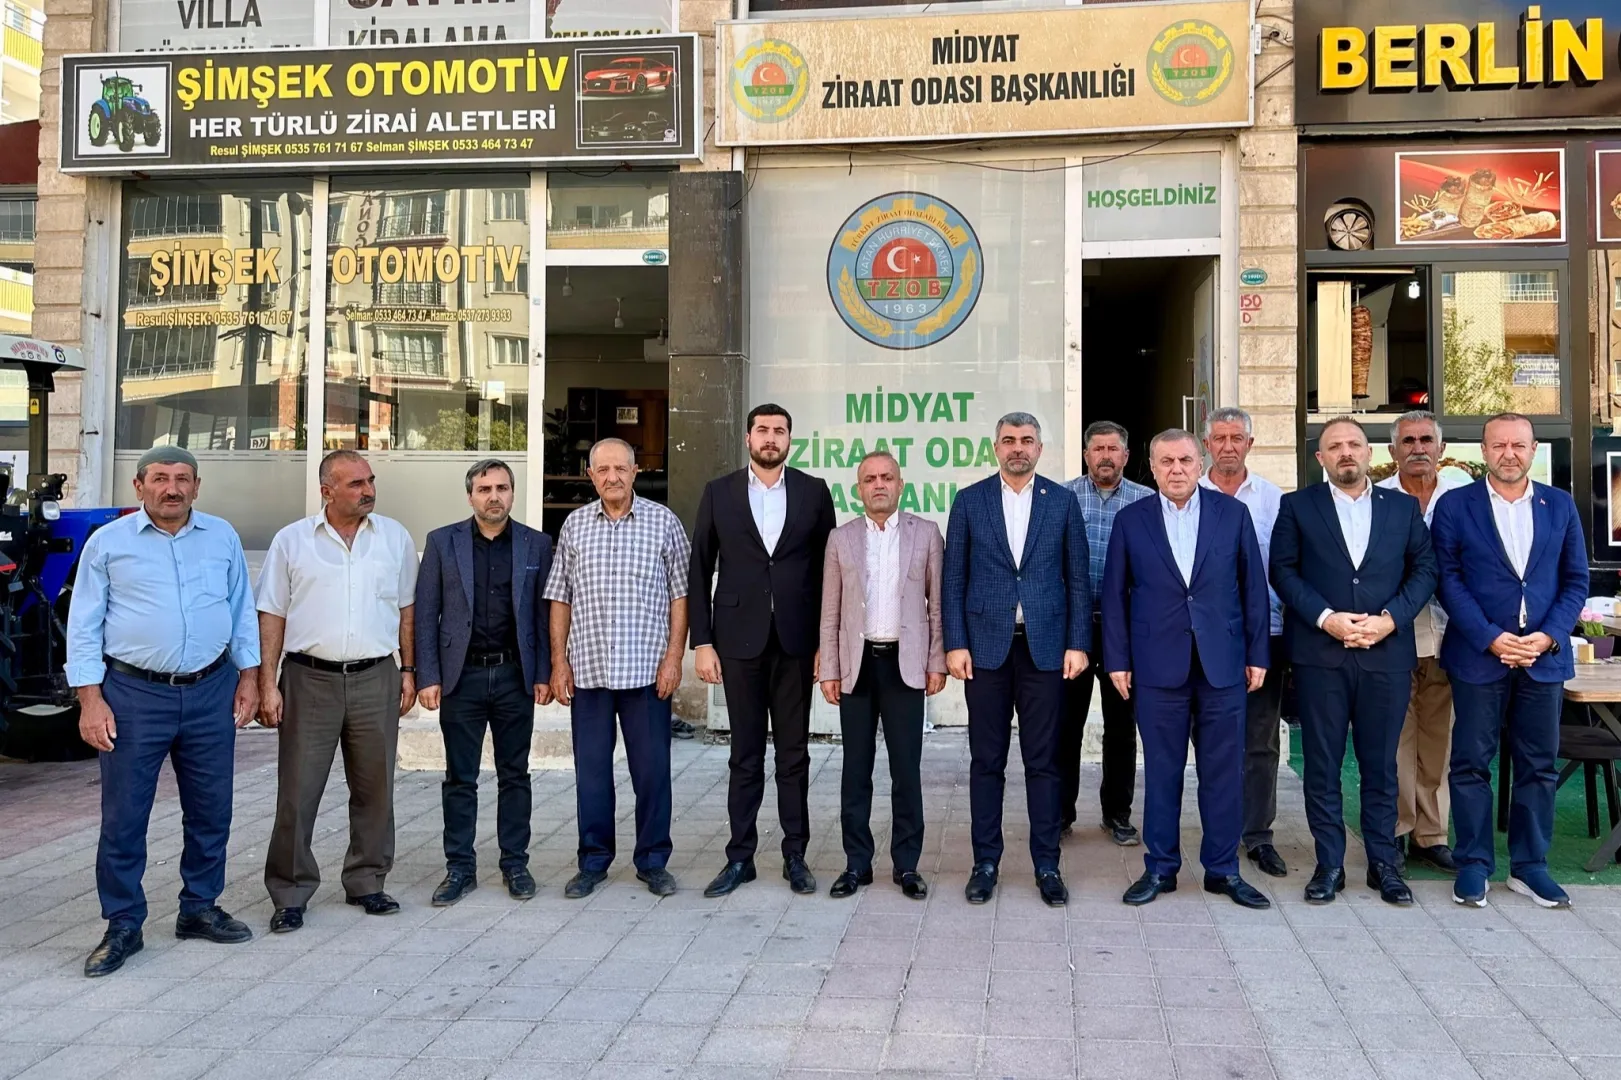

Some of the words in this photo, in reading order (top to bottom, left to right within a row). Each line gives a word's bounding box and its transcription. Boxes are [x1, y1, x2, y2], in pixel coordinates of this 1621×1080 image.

[932, 29, 1020, 65] MİDYAT
[1318, 4, 1604, 92] BERLİN
[176, 59, 334, 111] ŞİMŞEK
[346, 48, 569, 97] OTOMOTİV
[821, 74, 904, 109] ZİRAAT
[911, 74, 982, 106] ODASI
[990, 62, 1135, 106] BAŞKANLIĞI
[189, 117, 243, 138] HER
[250, 110, 338, 137] TÜRLÜ
[346, 108, 417, 134] ZİRAİ
[426, 104, 556, 132] ALETLERİ
[210, 145, 239, 156] Resul
[241, 142, 282, 158] ŞİMŞEK
[285, 143, 310, 154] 0535
[313, 142, 331, 154] 761
[335, 142, 347, 153] 71
[350, 141, 363, 153] 67
[366, 141, 405, 152] Selman
[408, 138, 450, 154] ŞİMŞEK
[452, 139, 479, 150] 0533
[481, 138, 501, 150] 464
[504, 138, 517, 150] 73
[520, 137, 534, 149] 47
[1087, 182, 1217, 210] HOŞGELDİNİZ
[150, 241, 282, 296] ŞİMŞEK
[331, 236, 523, 285] OTOMOTİV
[867, 279, 942, 298] TZOB
[1240, 293, 1263, 308] 150
[214, 311, 240, 325] 0535
[242, 311, 260, 325] 761
[264, 310, 277, 325] 71
[279, 310, 293, 325] 67
[883, 303, 927, 315] 1963
[1242, 312, 1252, 324] D
[845, 385, 975, 424] MİDYAT
[924, 436, 998, 468] ODA
